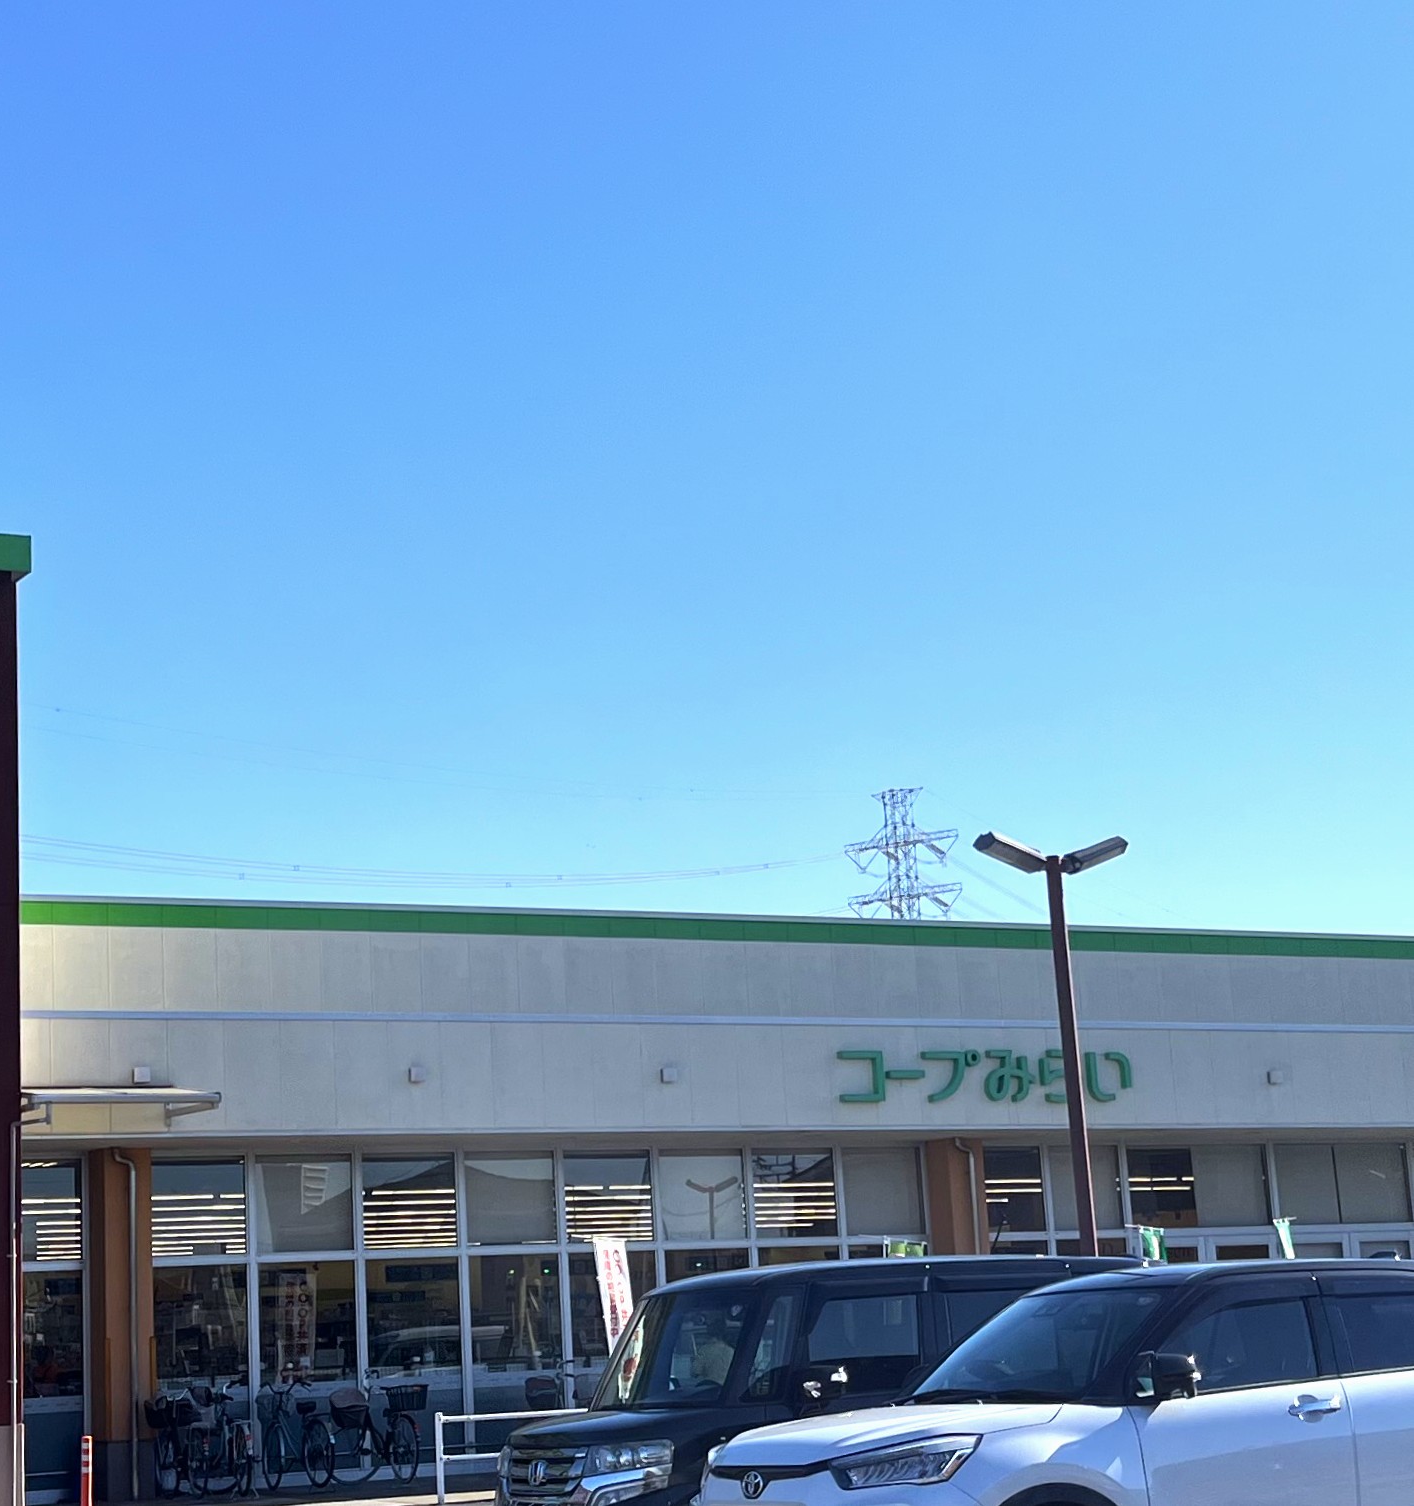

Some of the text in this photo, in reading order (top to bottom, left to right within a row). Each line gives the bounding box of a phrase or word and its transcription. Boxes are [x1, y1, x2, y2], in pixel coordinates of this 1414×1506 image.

[835, 1048, 1133, 1103] コープみらい
